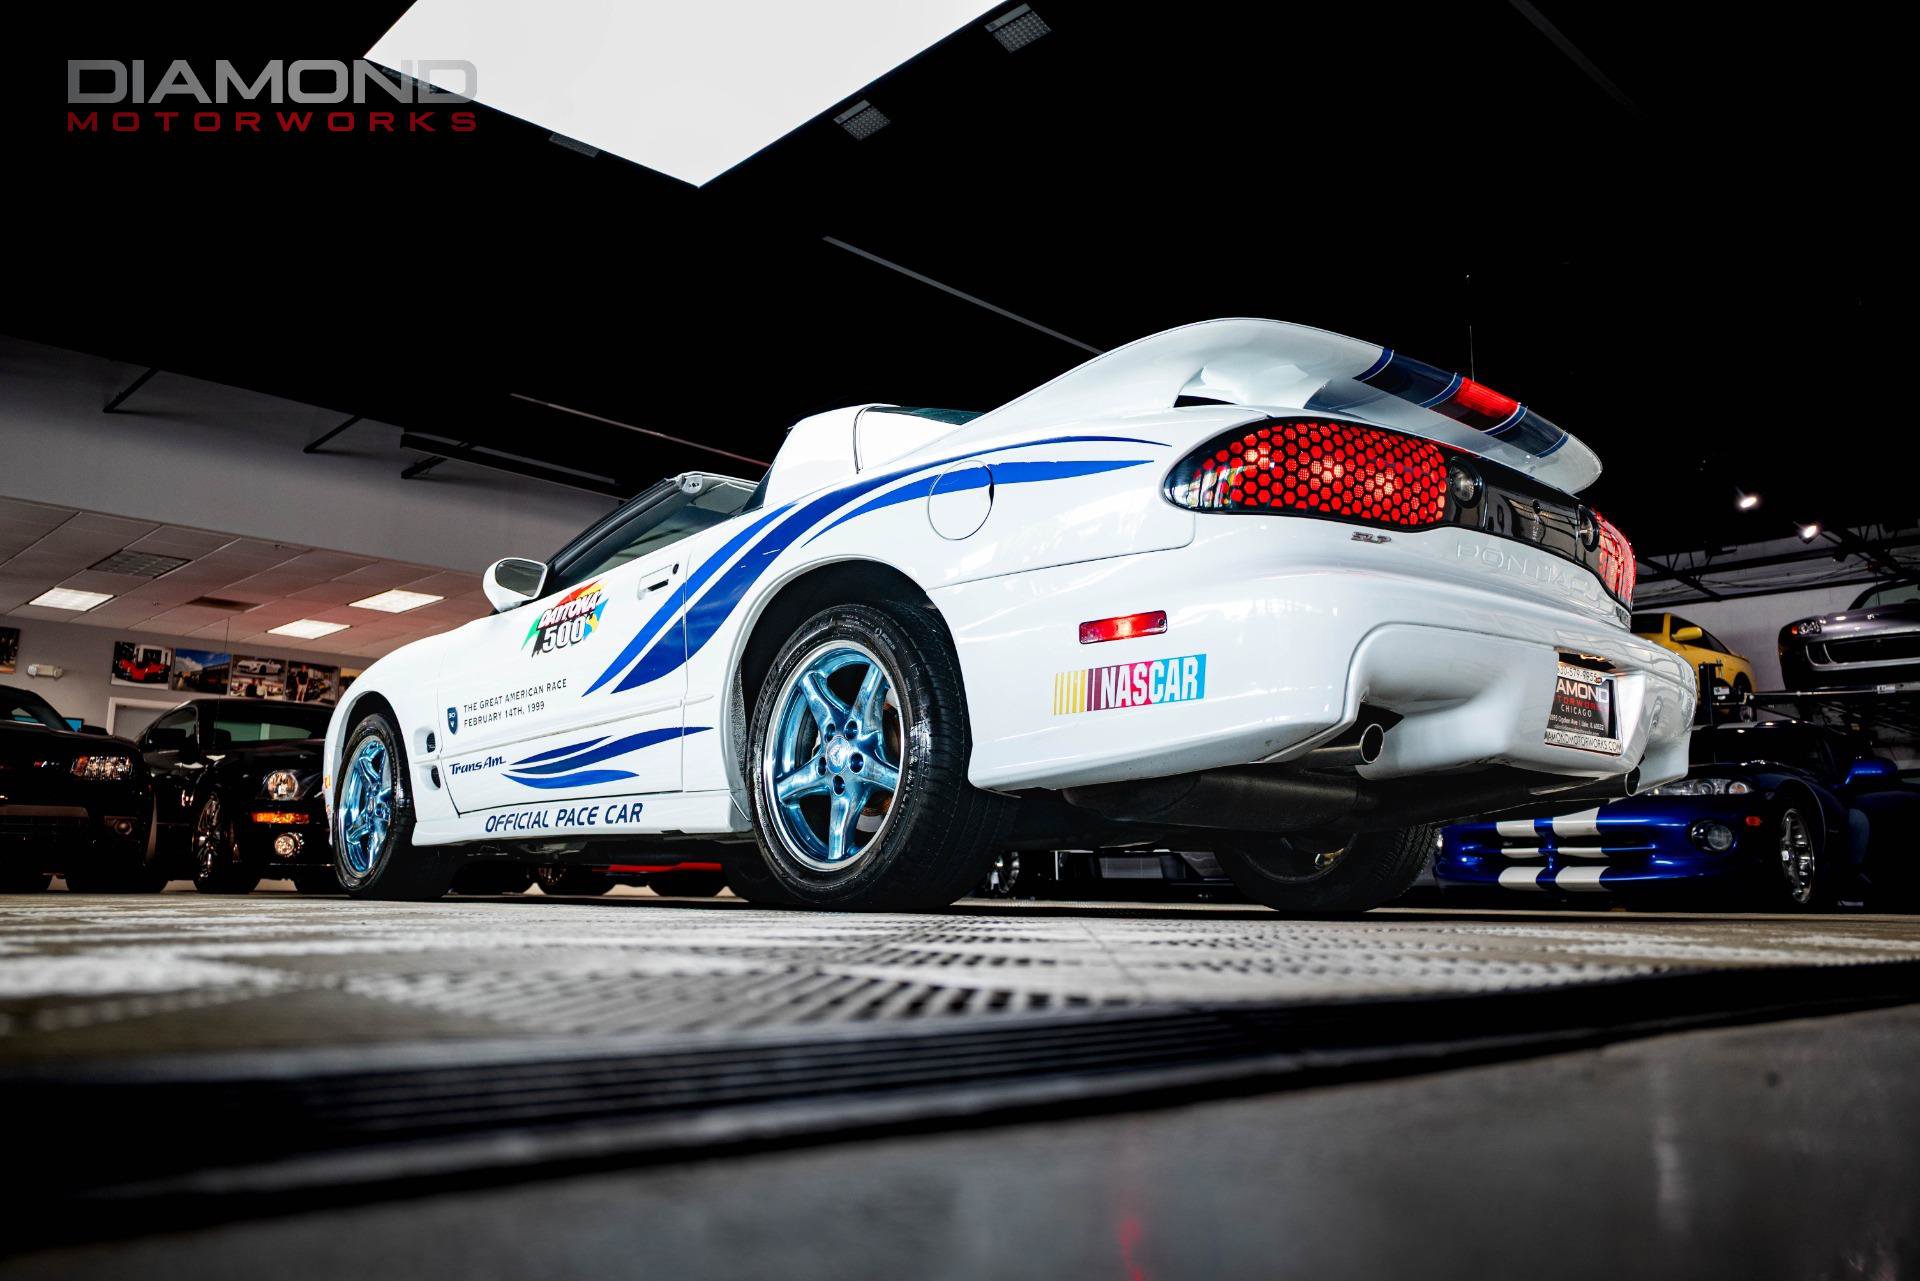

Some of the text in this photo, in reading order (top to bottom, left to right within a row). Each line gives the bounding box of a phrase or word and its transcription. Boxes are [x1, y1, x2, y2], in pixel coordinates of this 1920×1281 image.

[541, 615, 587, 653] 500
[463, 678, 567, 713] THE GREAT AMERICAN RACE
[1100, 656, 1198, 710] NASCAR
[463, 711, 502, 728] FEBRUARY
[527, 700, 545, 713] 1999
[1560, 704, 1592, 718] CHICAGO
[485, 802, 644, 833] OFFICIAL PACE CAR
